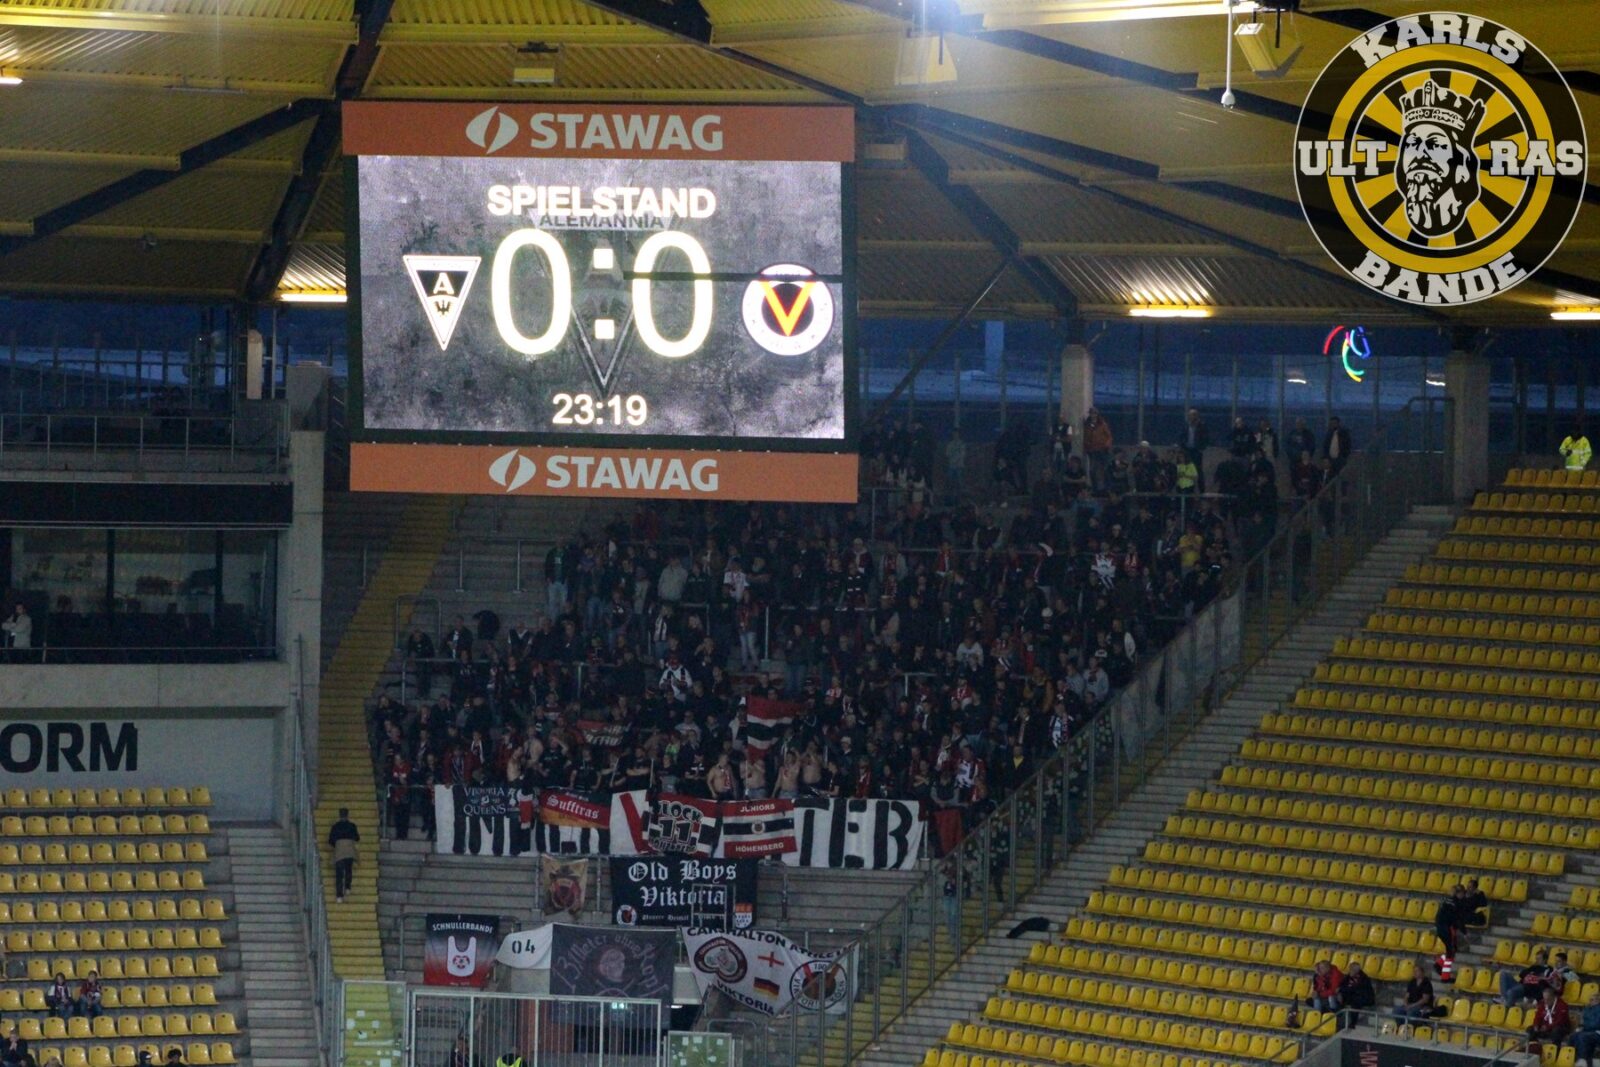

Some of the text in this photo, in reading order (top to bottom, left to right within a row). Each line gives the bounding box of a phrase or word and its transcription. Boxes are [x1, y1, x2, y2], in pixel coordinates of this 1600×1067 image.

[529, 113, 724, 152] STAWAG
[487, 186, 716, 219] SPIELSTAND
[539, 213, 664, 228] ALEMANNIA
[551, 394, 647, 427] 23:19
[545, 455, 719, 492] STAWAG
[0, 722, 138, 773] ORM
[628, 859, 737, 884] Old Boys
[639, 885, 725, 908] Viktoria
[716, 979, 776, 1017] VIKTORIA
